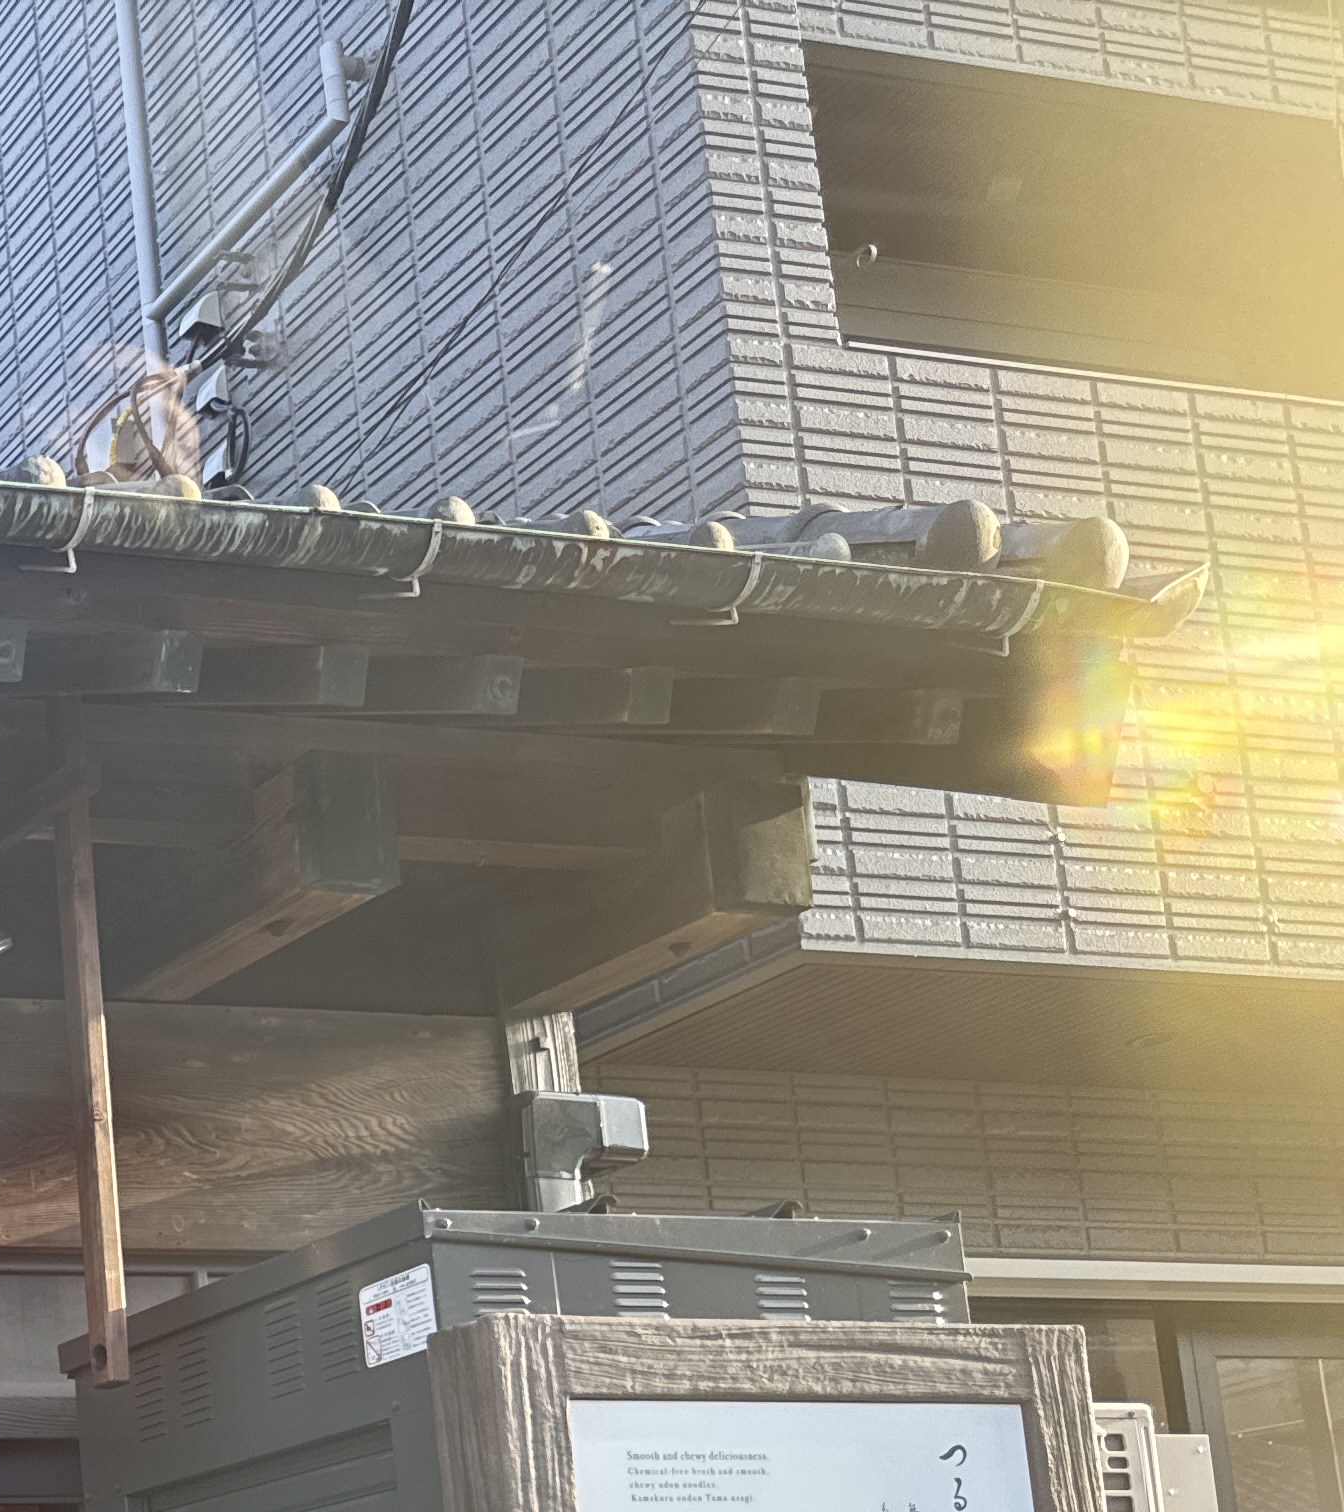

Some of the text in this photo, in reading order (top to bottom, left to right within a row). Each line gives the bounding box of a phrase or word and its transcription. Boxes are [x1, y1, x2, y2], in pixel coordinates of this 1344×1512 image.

[626, 1450, 769, 1463] Smooth and chewy deliciousness.
[718, 1467, 733, 1475] and
[629, 1481, 655, 1490] chewy
[631, 1494, 674, 1502] Kamakura
